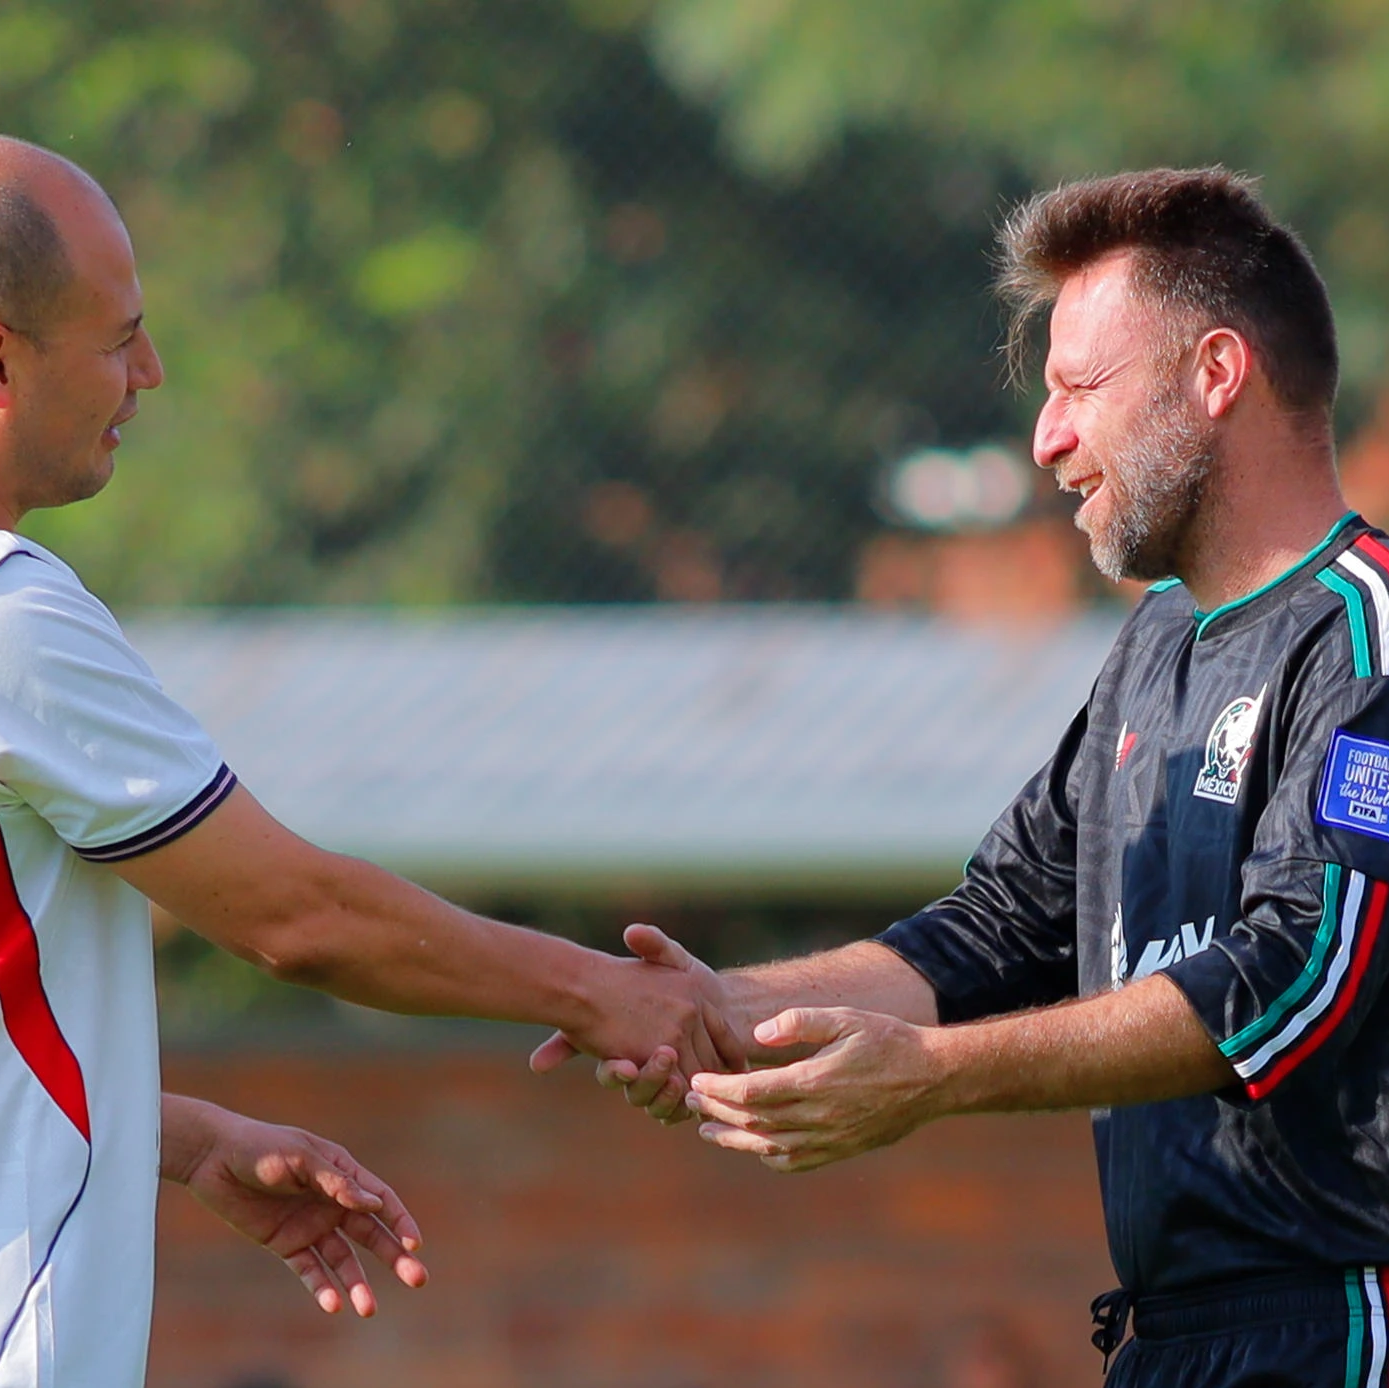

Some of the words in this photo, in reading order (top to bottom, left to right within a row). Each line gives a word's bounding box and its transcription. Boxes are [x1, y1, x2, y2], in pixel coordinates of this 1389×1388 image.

[1198, 774, 1237, 797] MÉXICO
[1339, 781, 1360, 799] the
[1352, 804, 1378, 819] FIFA
